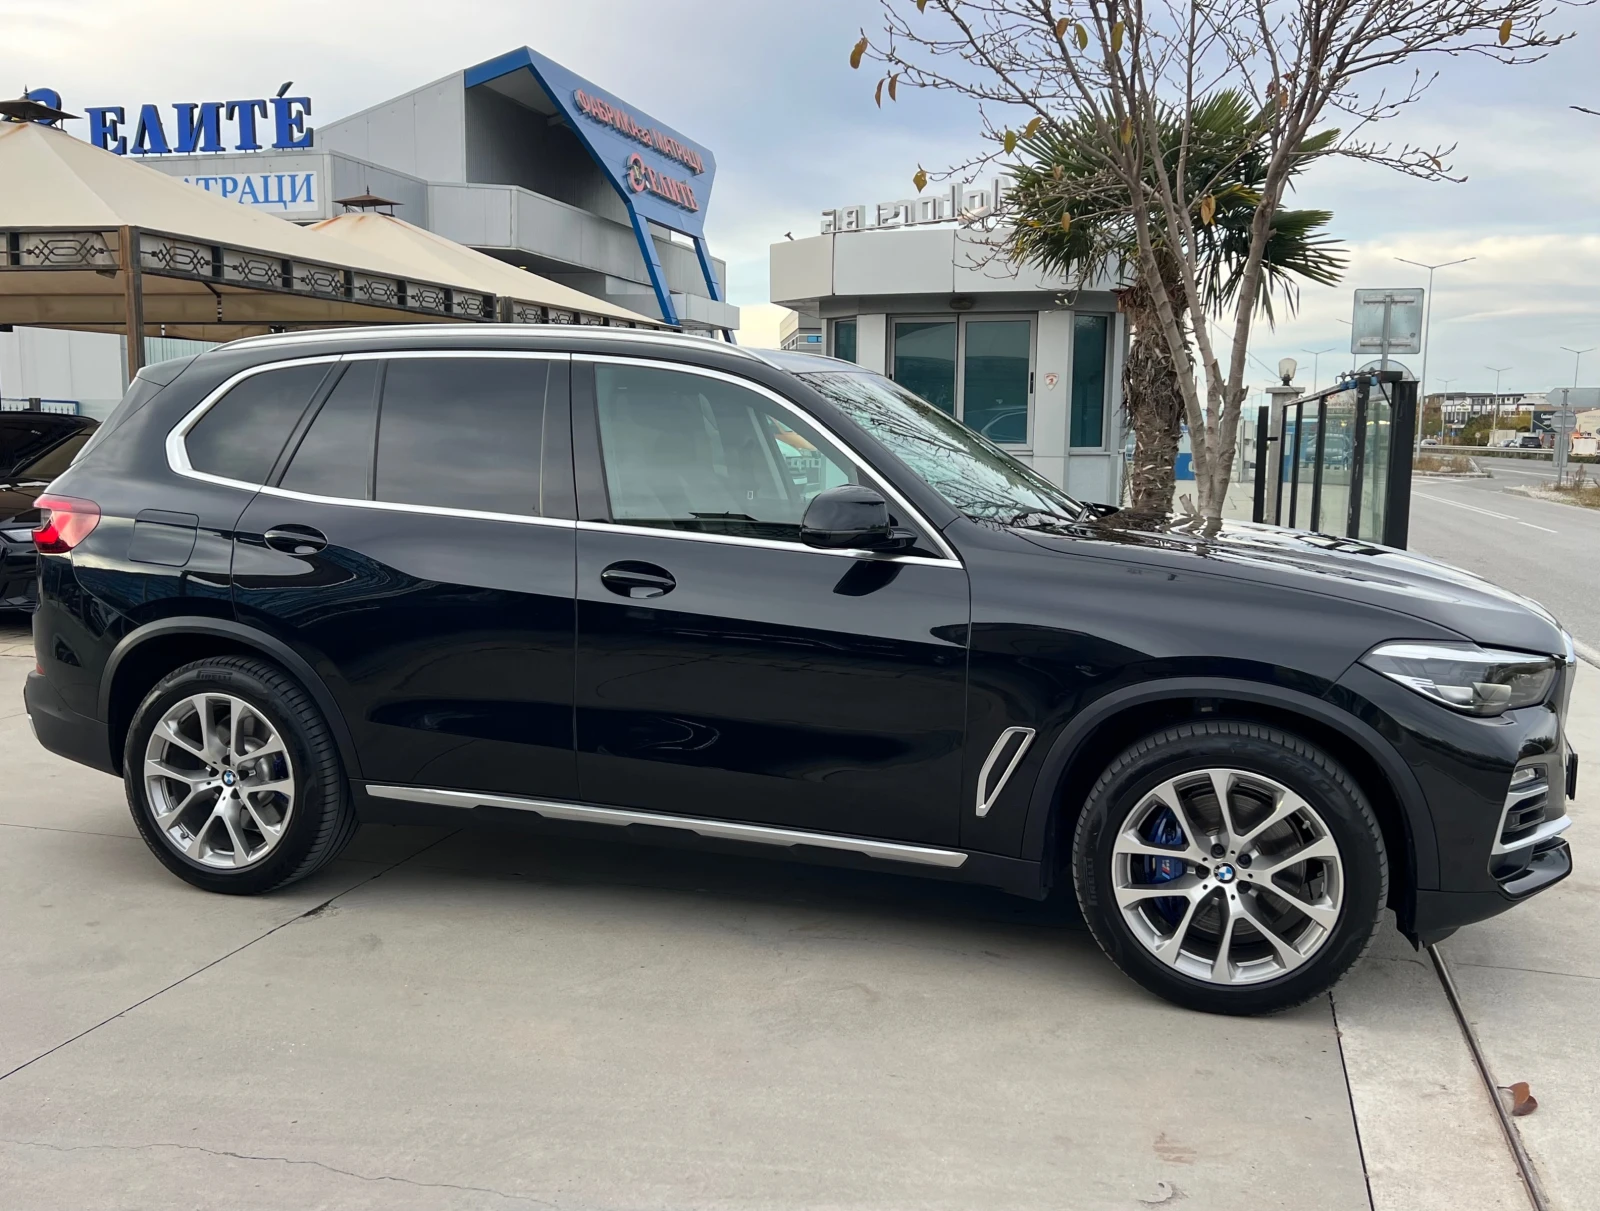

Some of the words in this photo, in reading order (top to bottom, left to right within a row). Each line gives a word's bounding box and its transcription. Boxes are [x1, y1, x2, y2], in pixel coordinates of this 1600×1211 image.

[573, 88, 640, 137] ФАБРИКА
[650, 127, 705, 176] МАТРАЦИ
[184, 173, 315, 210] ТРАЦИ
